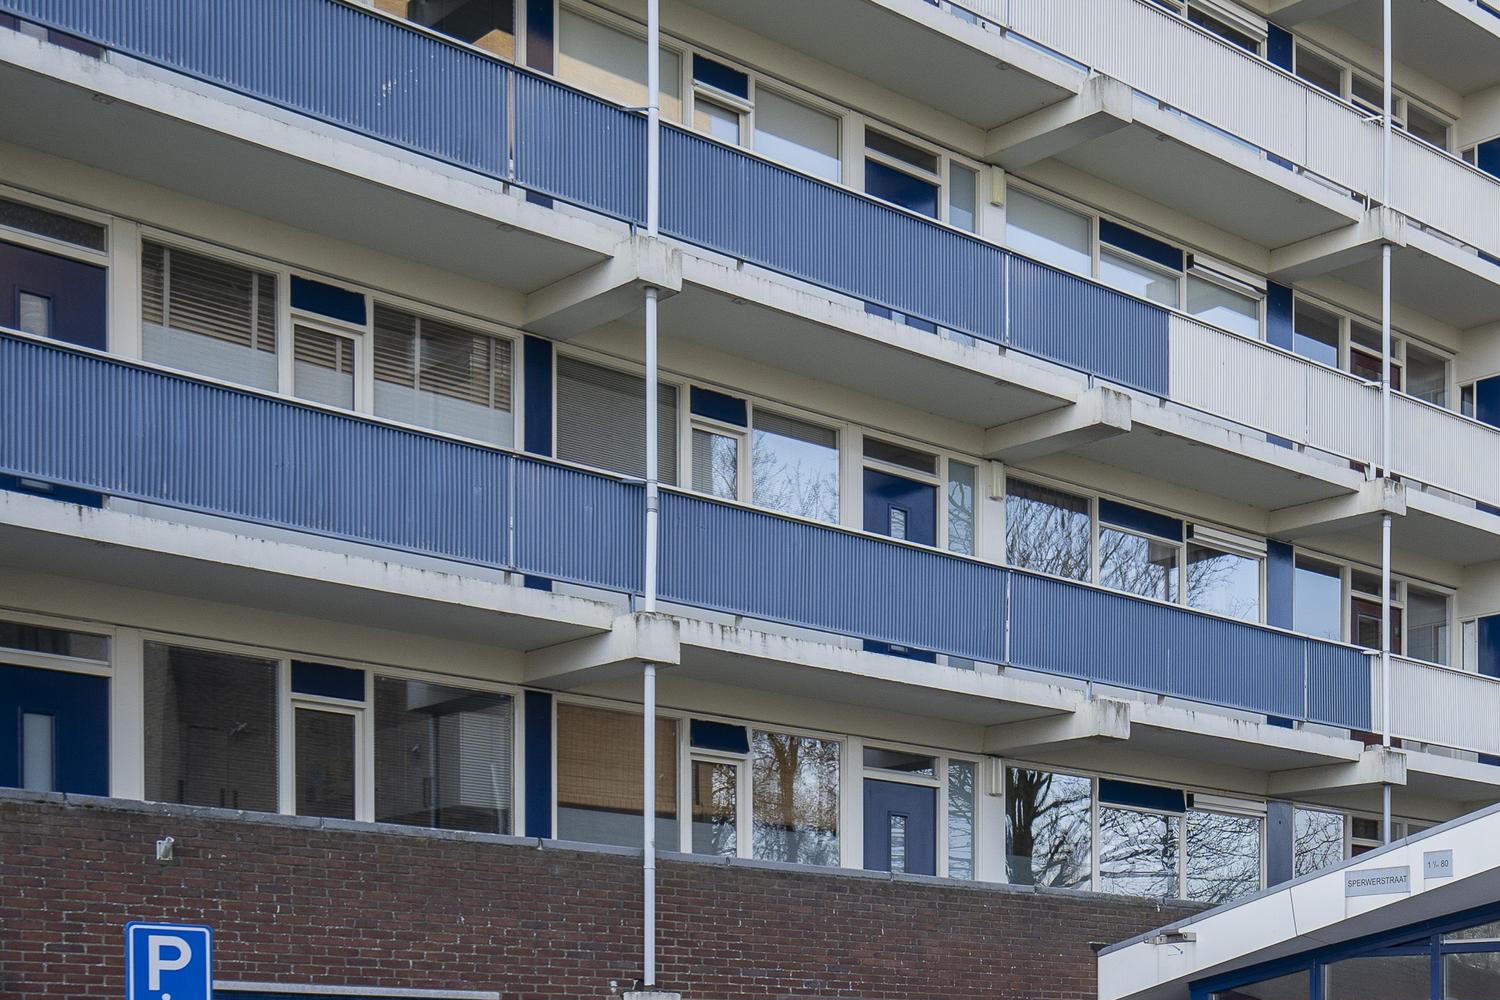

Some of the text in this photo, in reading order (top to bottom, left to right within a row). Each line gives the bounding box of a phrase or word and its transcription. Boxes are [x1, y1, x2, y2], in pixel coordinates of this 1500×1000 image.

[1427, 861, 1431, 869] 1
[1440, 859, 1449, 868] 80
[1347, 875, 1408, 888] SPERWERSTRAAT
[148, 934, 192, 991] P
